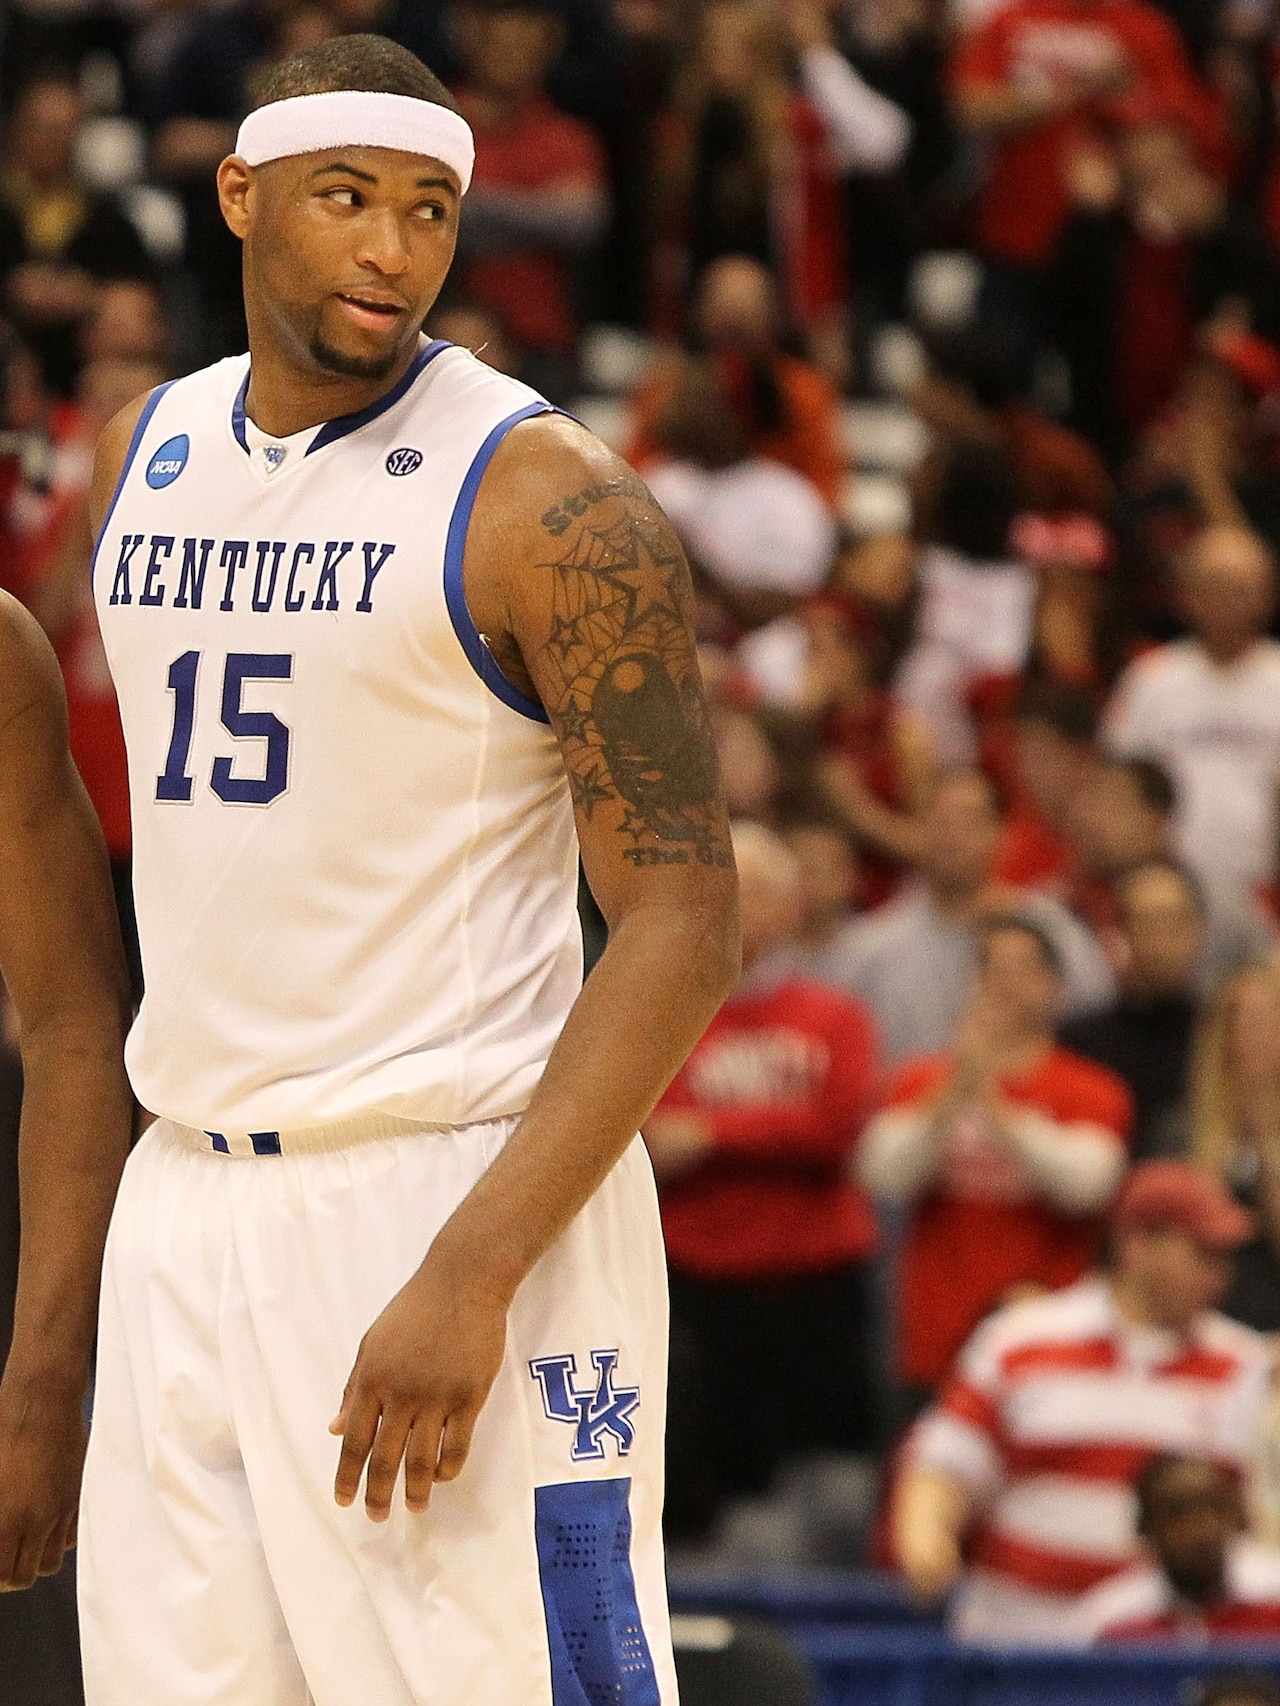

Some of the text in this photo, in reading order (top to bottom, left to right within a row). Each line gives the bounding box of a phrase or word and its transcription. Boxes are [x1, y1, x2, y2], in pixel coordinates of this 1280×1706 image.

[150, 460, 183, 475] NCAA
[388, 449, 421, 475] SEC
[109, 534, 396, 613] KENTUCKY
[153, 650, 296, 809] 15
[528, 1348, 641, 1462] UK
